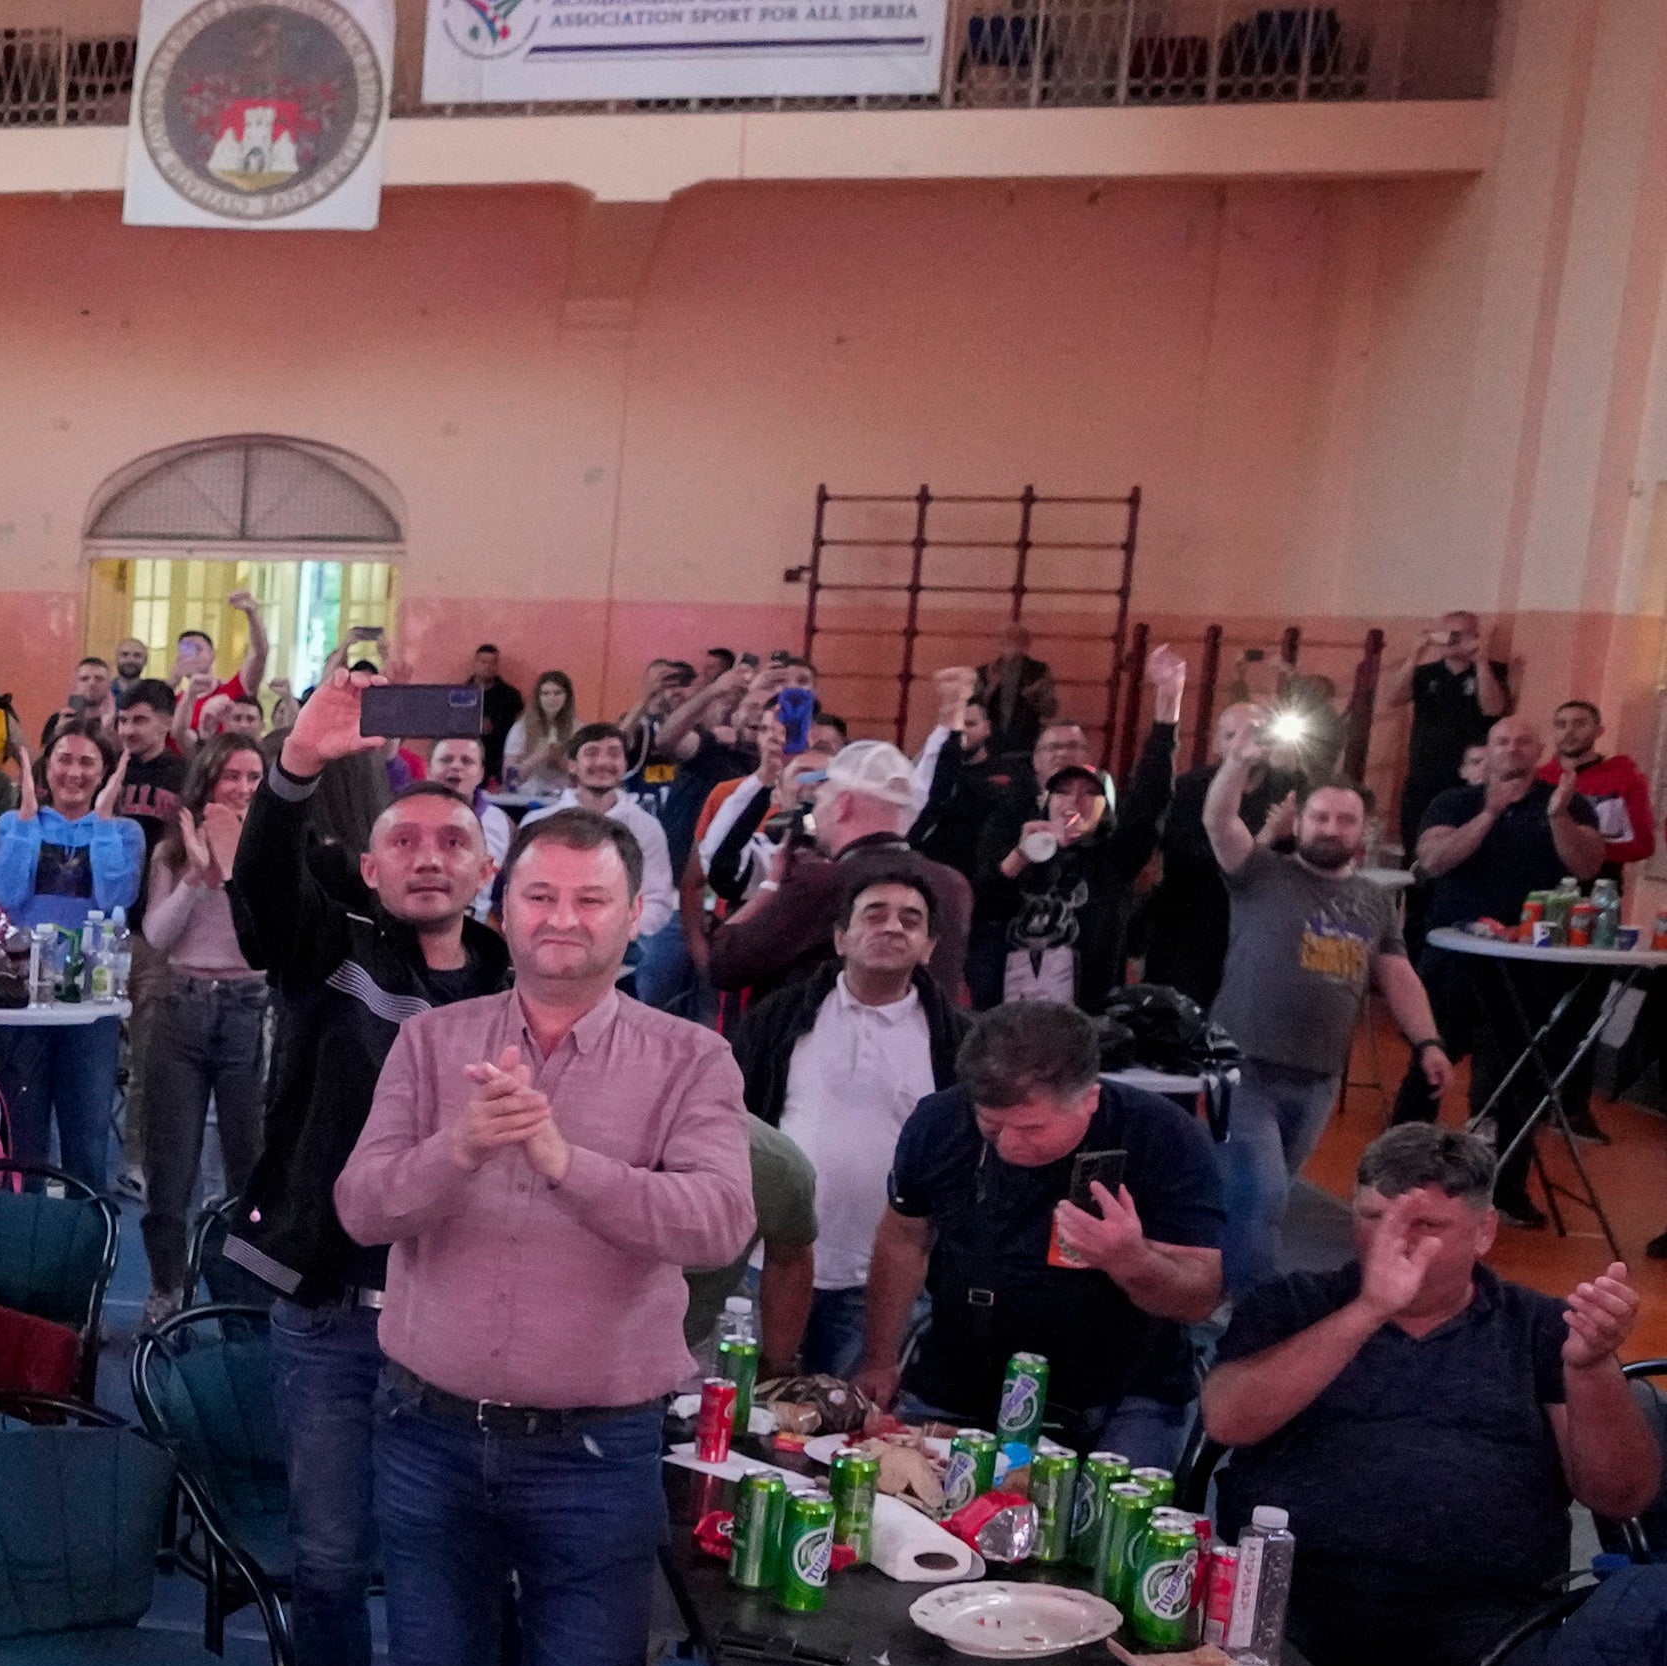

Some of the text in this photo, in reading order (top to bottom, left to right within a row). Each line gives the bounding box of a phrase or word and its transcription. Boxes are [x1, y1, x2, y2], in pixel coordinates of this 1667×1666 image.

[550, 11, 683, 28] ASSOCIATION
[689, 9, 752, 24] SPORT
[758, 7, 799, 22] FOR
[805, 6, 839, 21] ALL
